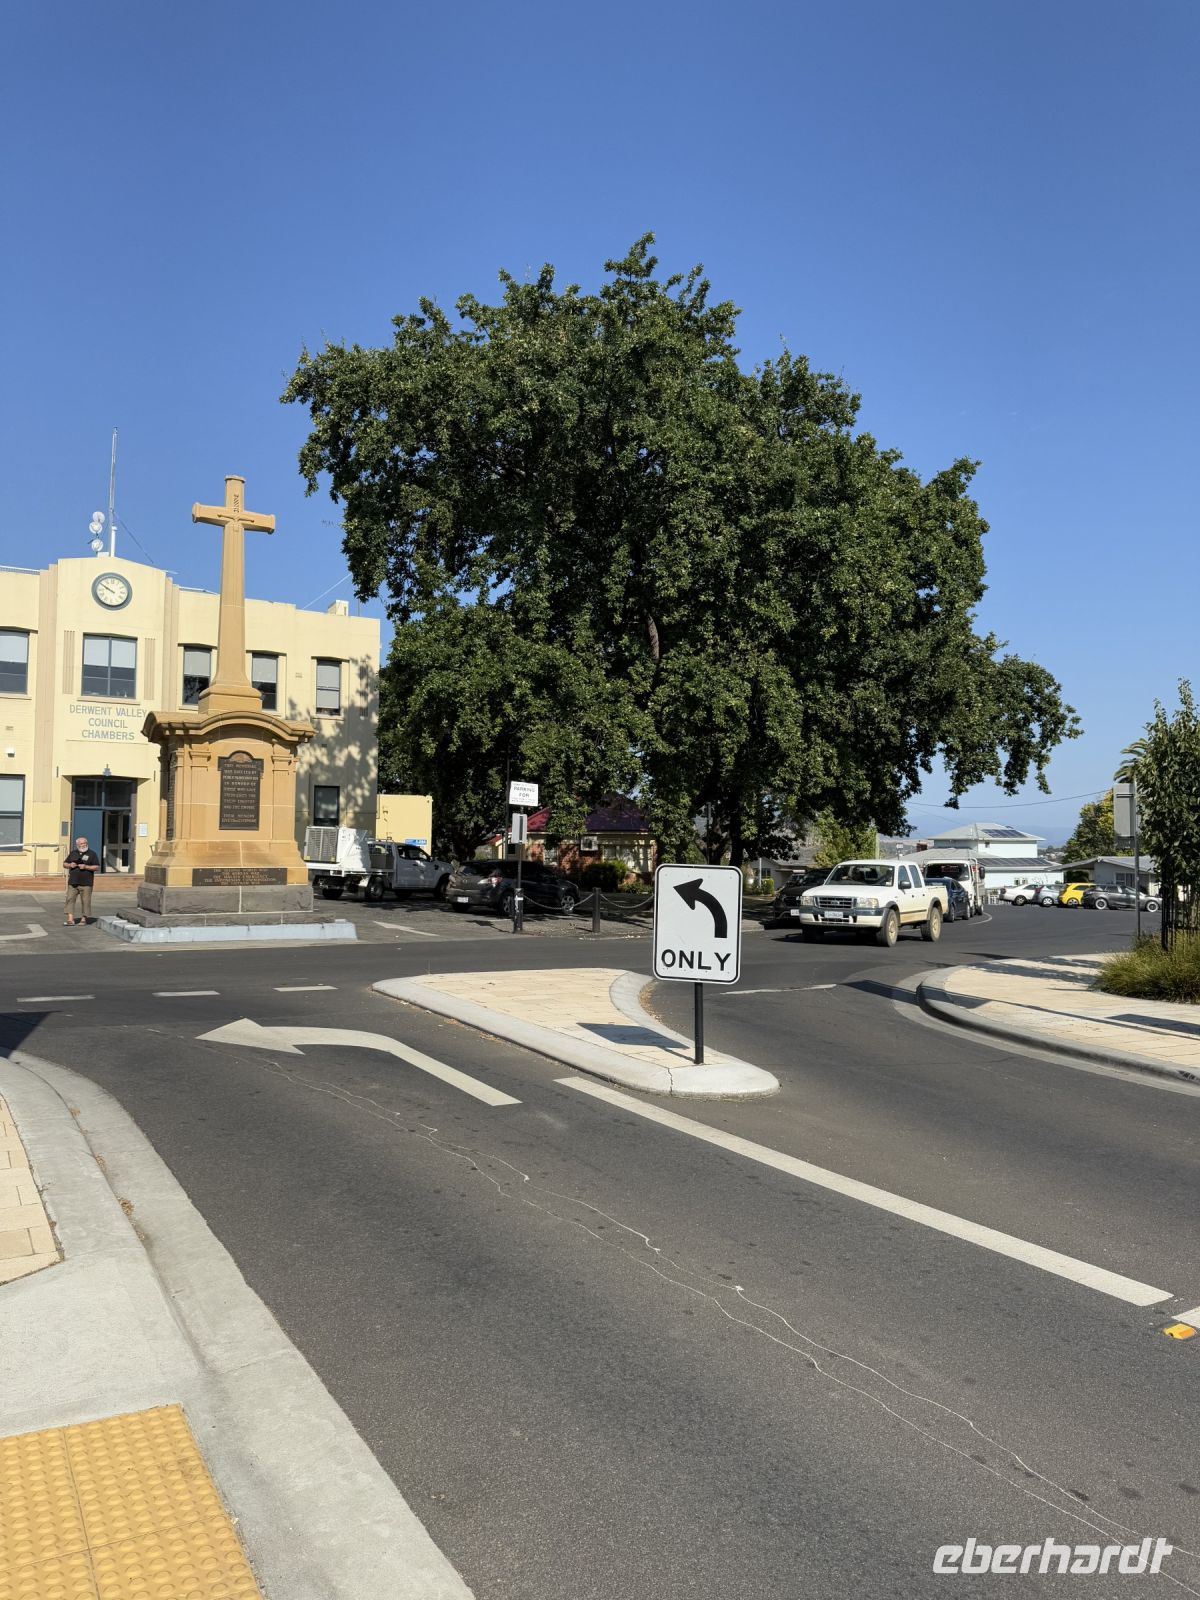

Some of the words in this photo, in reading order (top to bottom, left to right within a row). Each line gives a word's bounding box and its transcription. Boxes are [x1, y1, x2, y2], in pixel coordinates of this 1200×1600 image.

[69, 704, 112, 716] DERWENT
[115, 707, 147, 718] VALLEY
[88, 717, 128, 728] COUNCIL
[81, 729, 135, 741] CHAMBERS
[661, 949, 731, 971] ONLY
